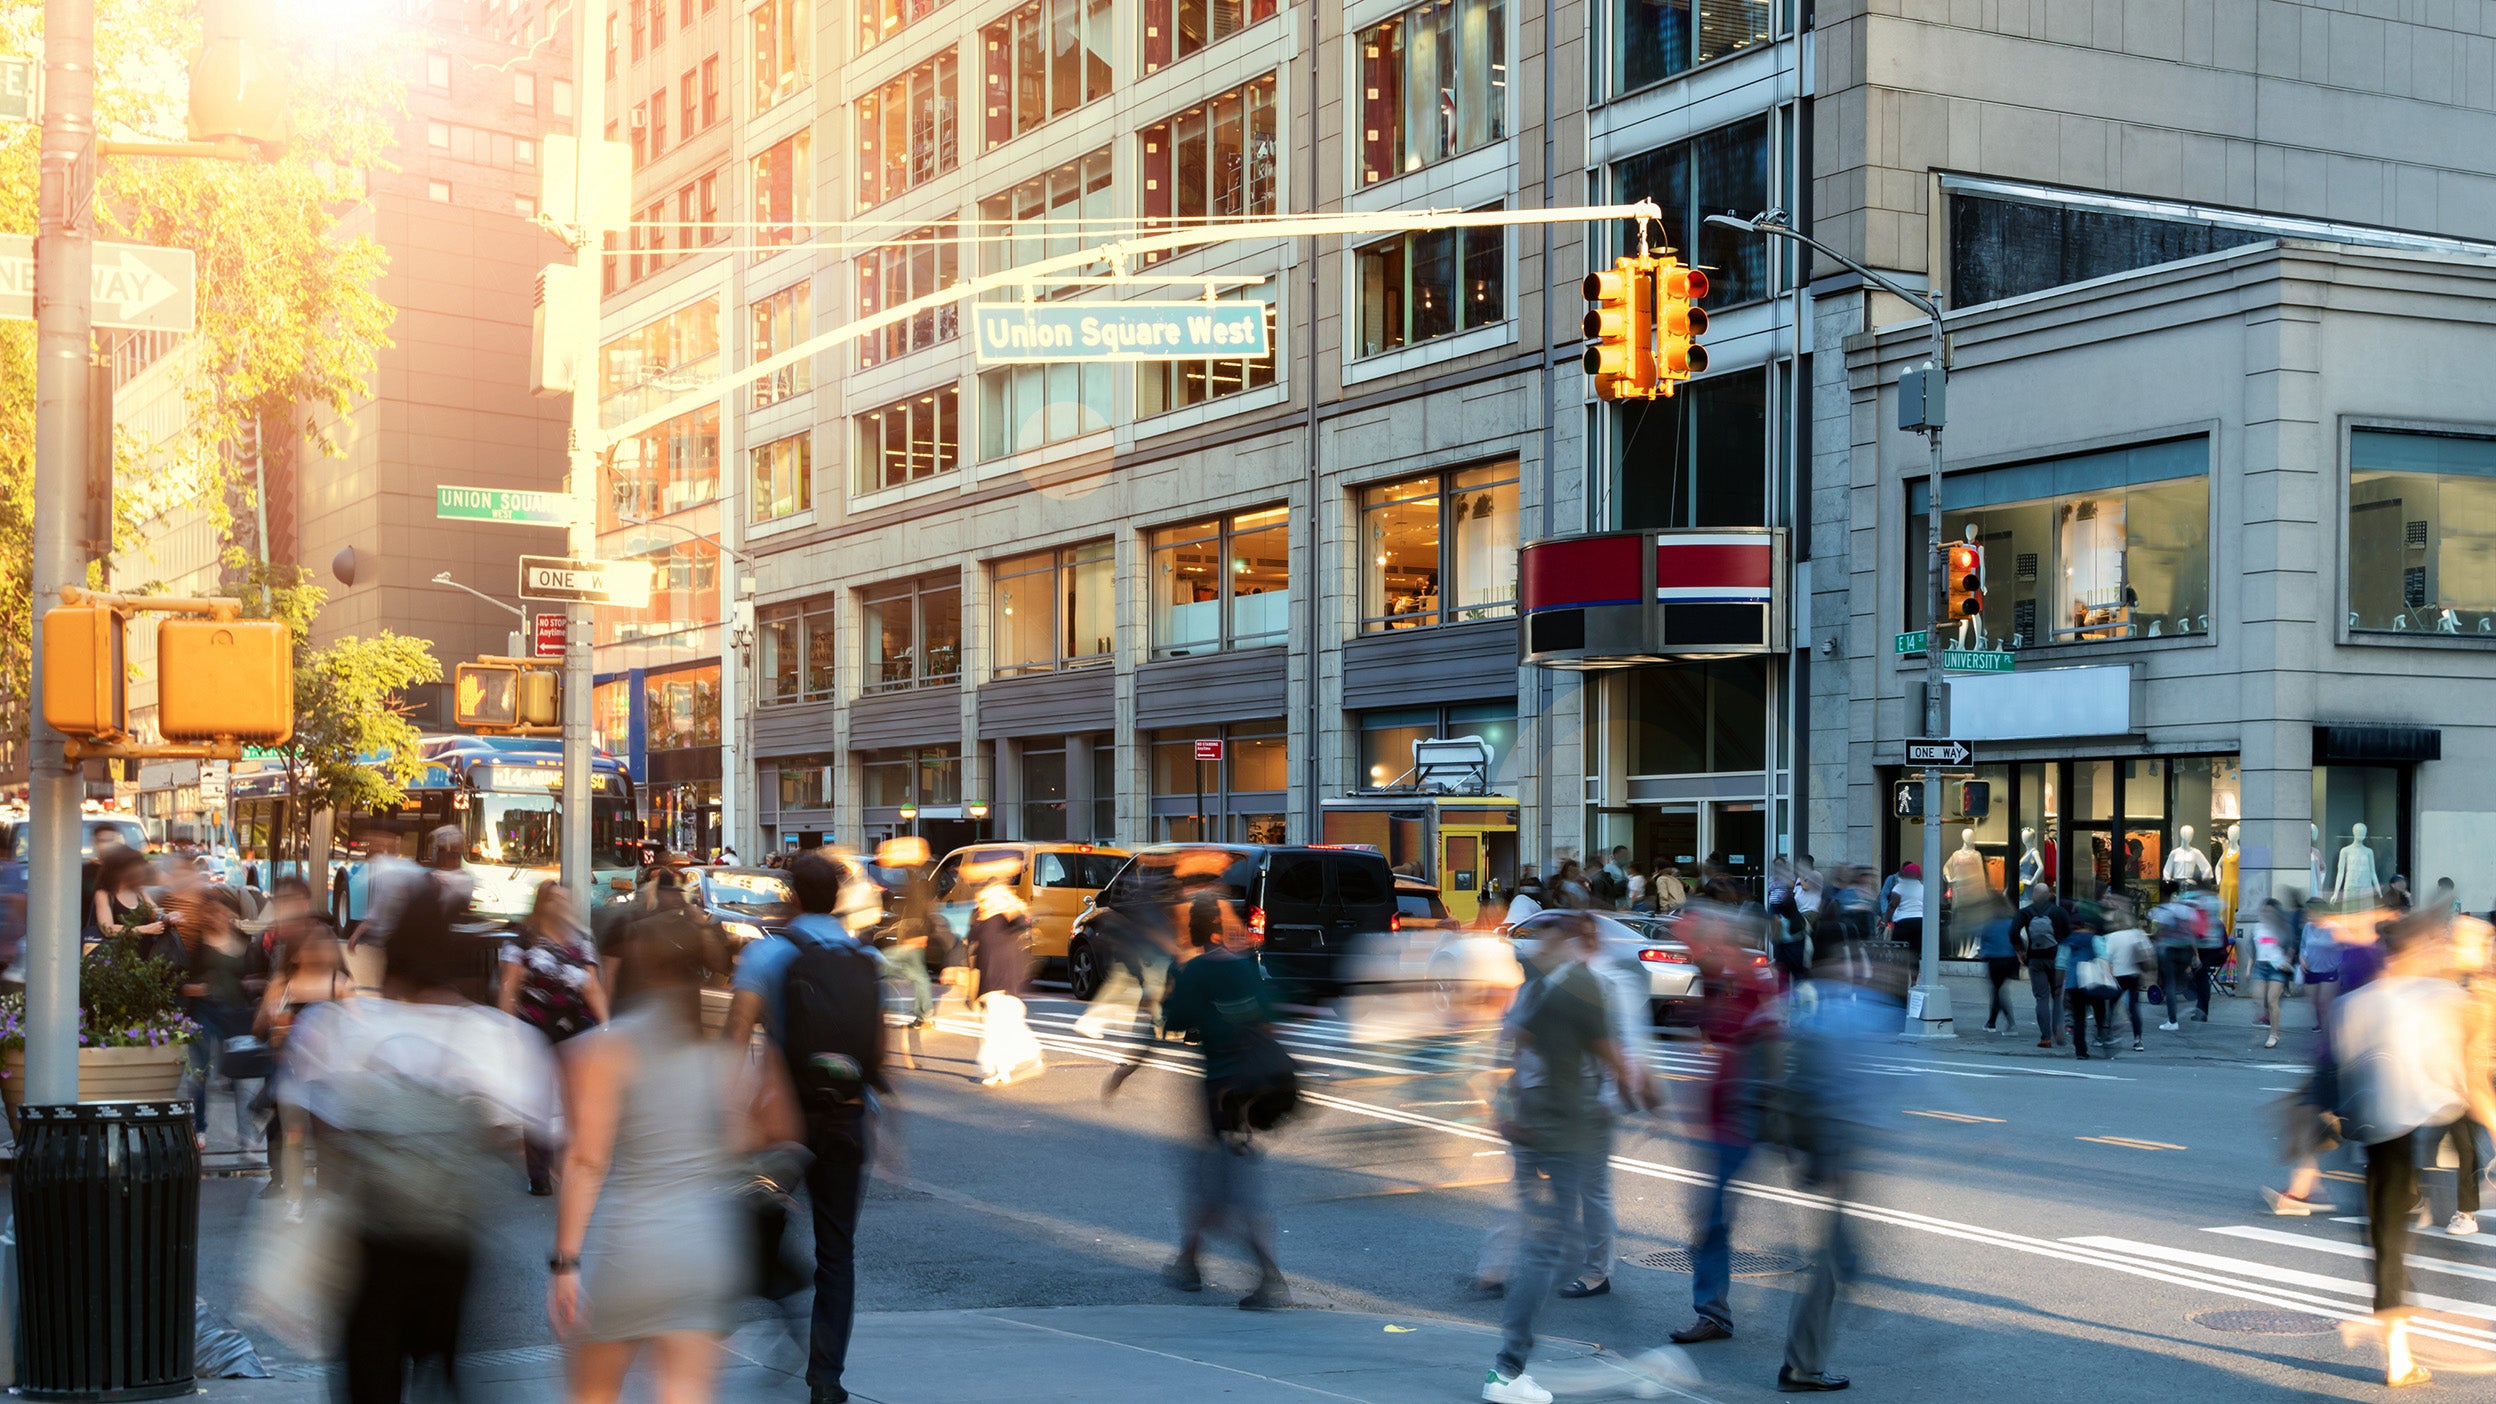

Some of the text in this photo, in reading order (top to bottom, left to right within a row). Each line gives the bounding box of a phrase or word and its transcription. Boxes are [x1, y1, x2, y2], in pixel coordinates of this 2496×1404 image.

[0, 261, 33, 292] NE
[986, 314, 1255, 353] Union Square West
[441, 489, 492, 509] UNION
[492, 509, 513, 520] WEST
[539, 571, 575, 588] ONE
[539, 618, 567, 627] NO STOP
[1898, 633, 1925, 652] E 14 ST
[1944, 652, 2012, 669] UNIVERSITY PL
[1915, 747, 1963, 758] ONE WAY
[590, 773, 606, 790] SQ
